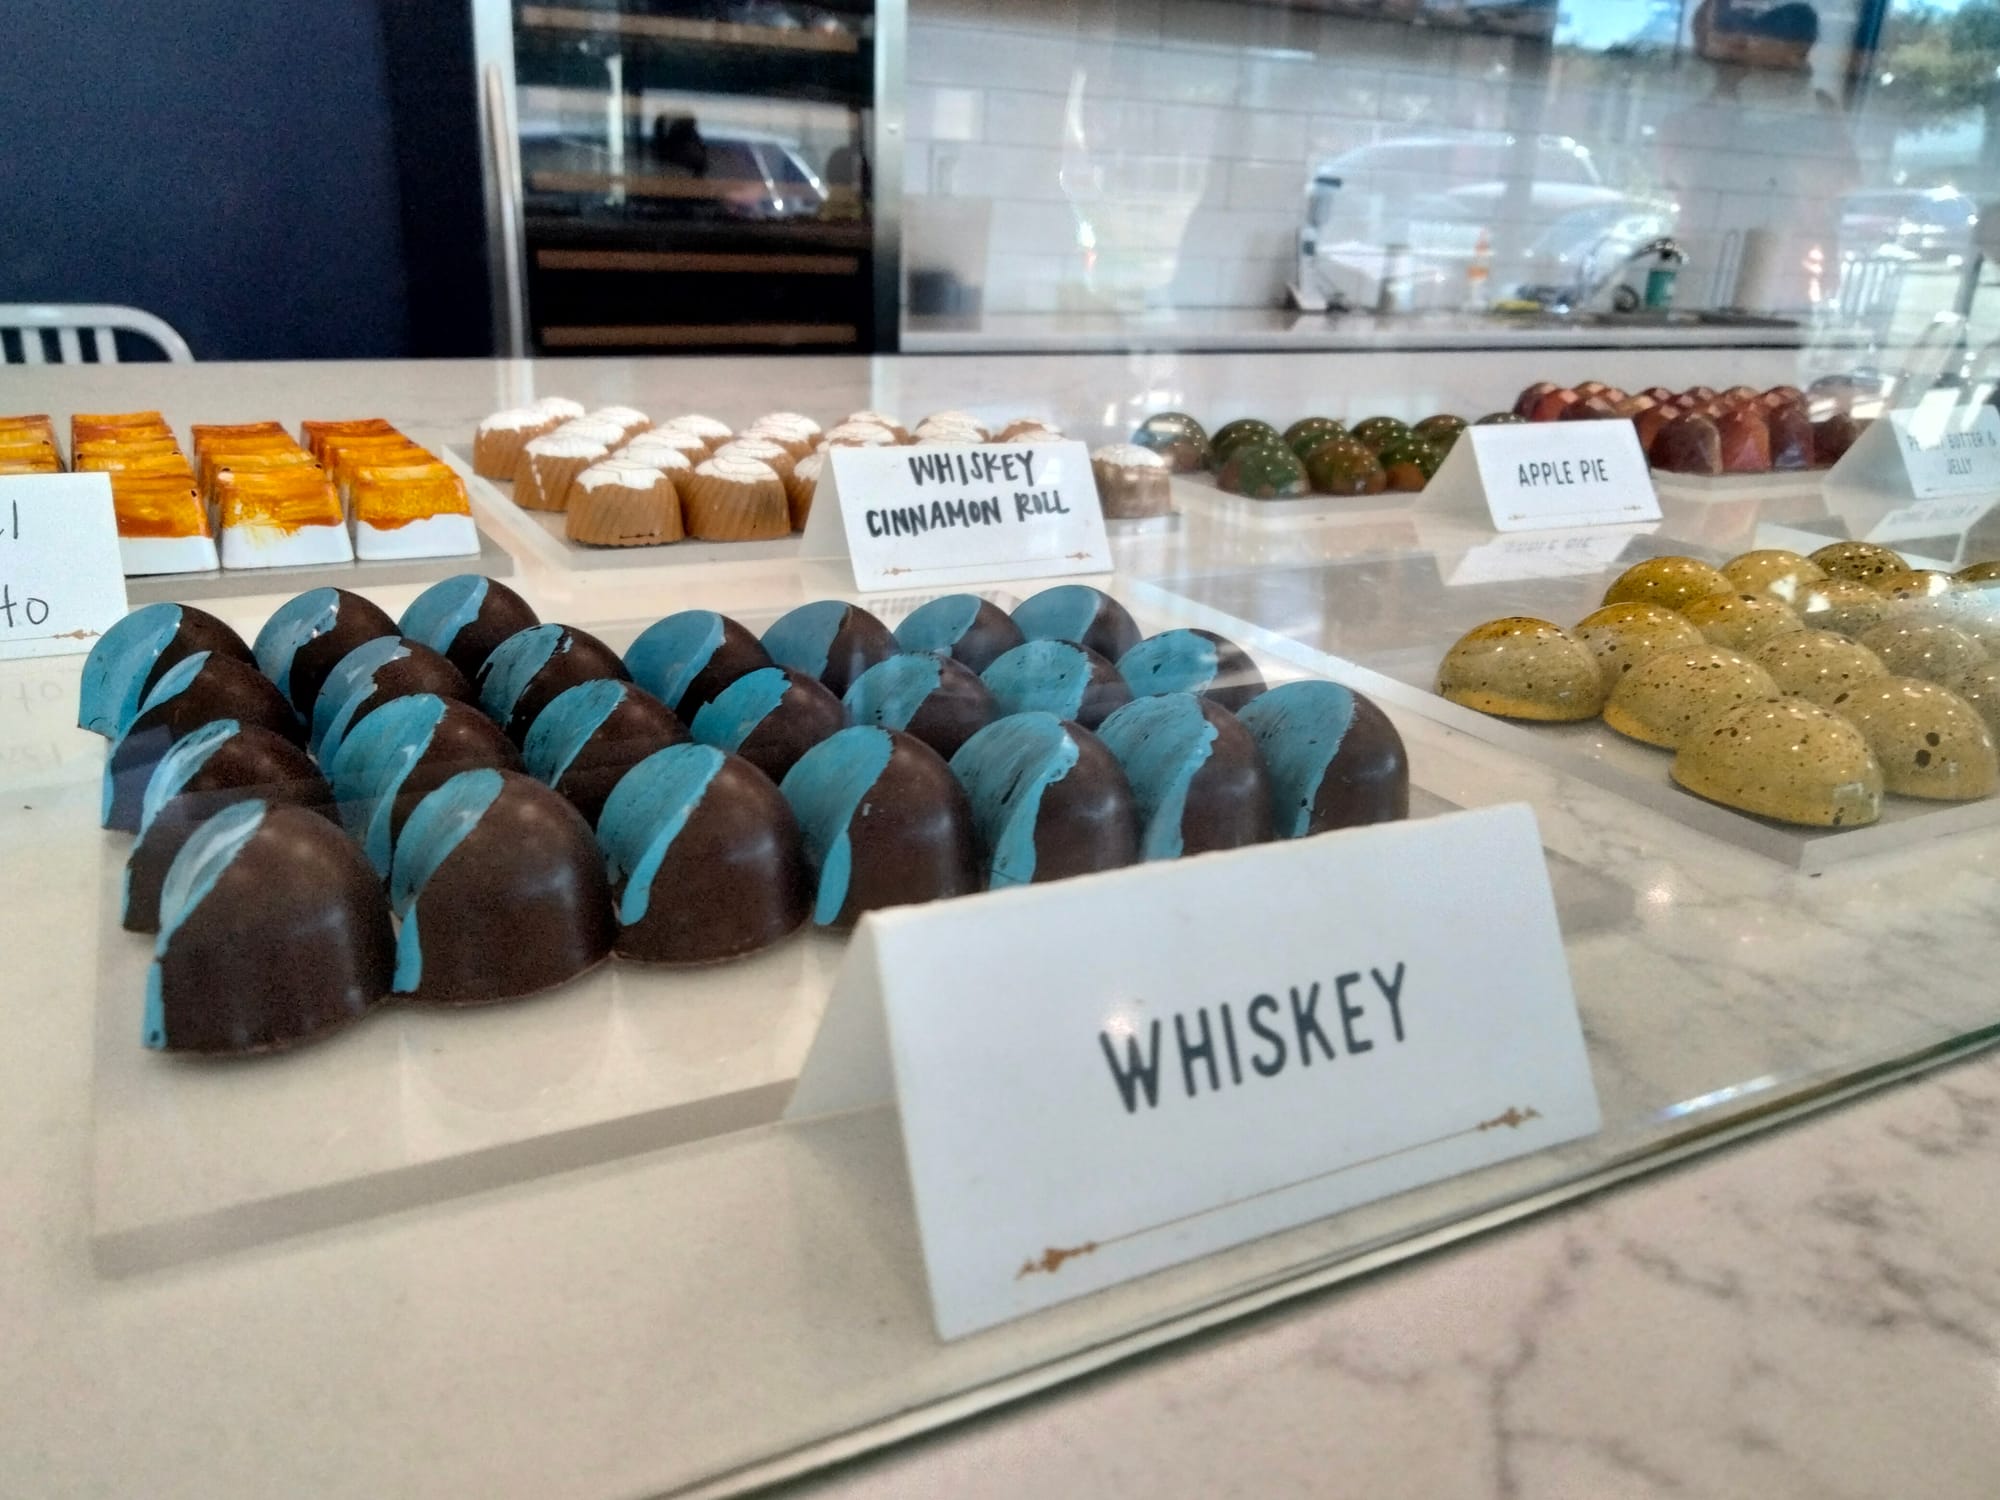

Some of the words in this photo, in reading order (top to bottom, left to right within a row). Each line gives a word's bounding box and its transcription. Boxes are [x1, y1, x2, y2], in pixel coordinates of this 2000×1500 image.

[908, 450, 1035, 486] WHISKEY
[1518, 460, 1574, 487] APPLE
[1581, 459, 1609, 483] PIE
[866, 495, 1002, 538] CINNAMON
[1014, 490, 1070, 522] ROLL
[1098, 961, 1406, 1114] WHISKEY
